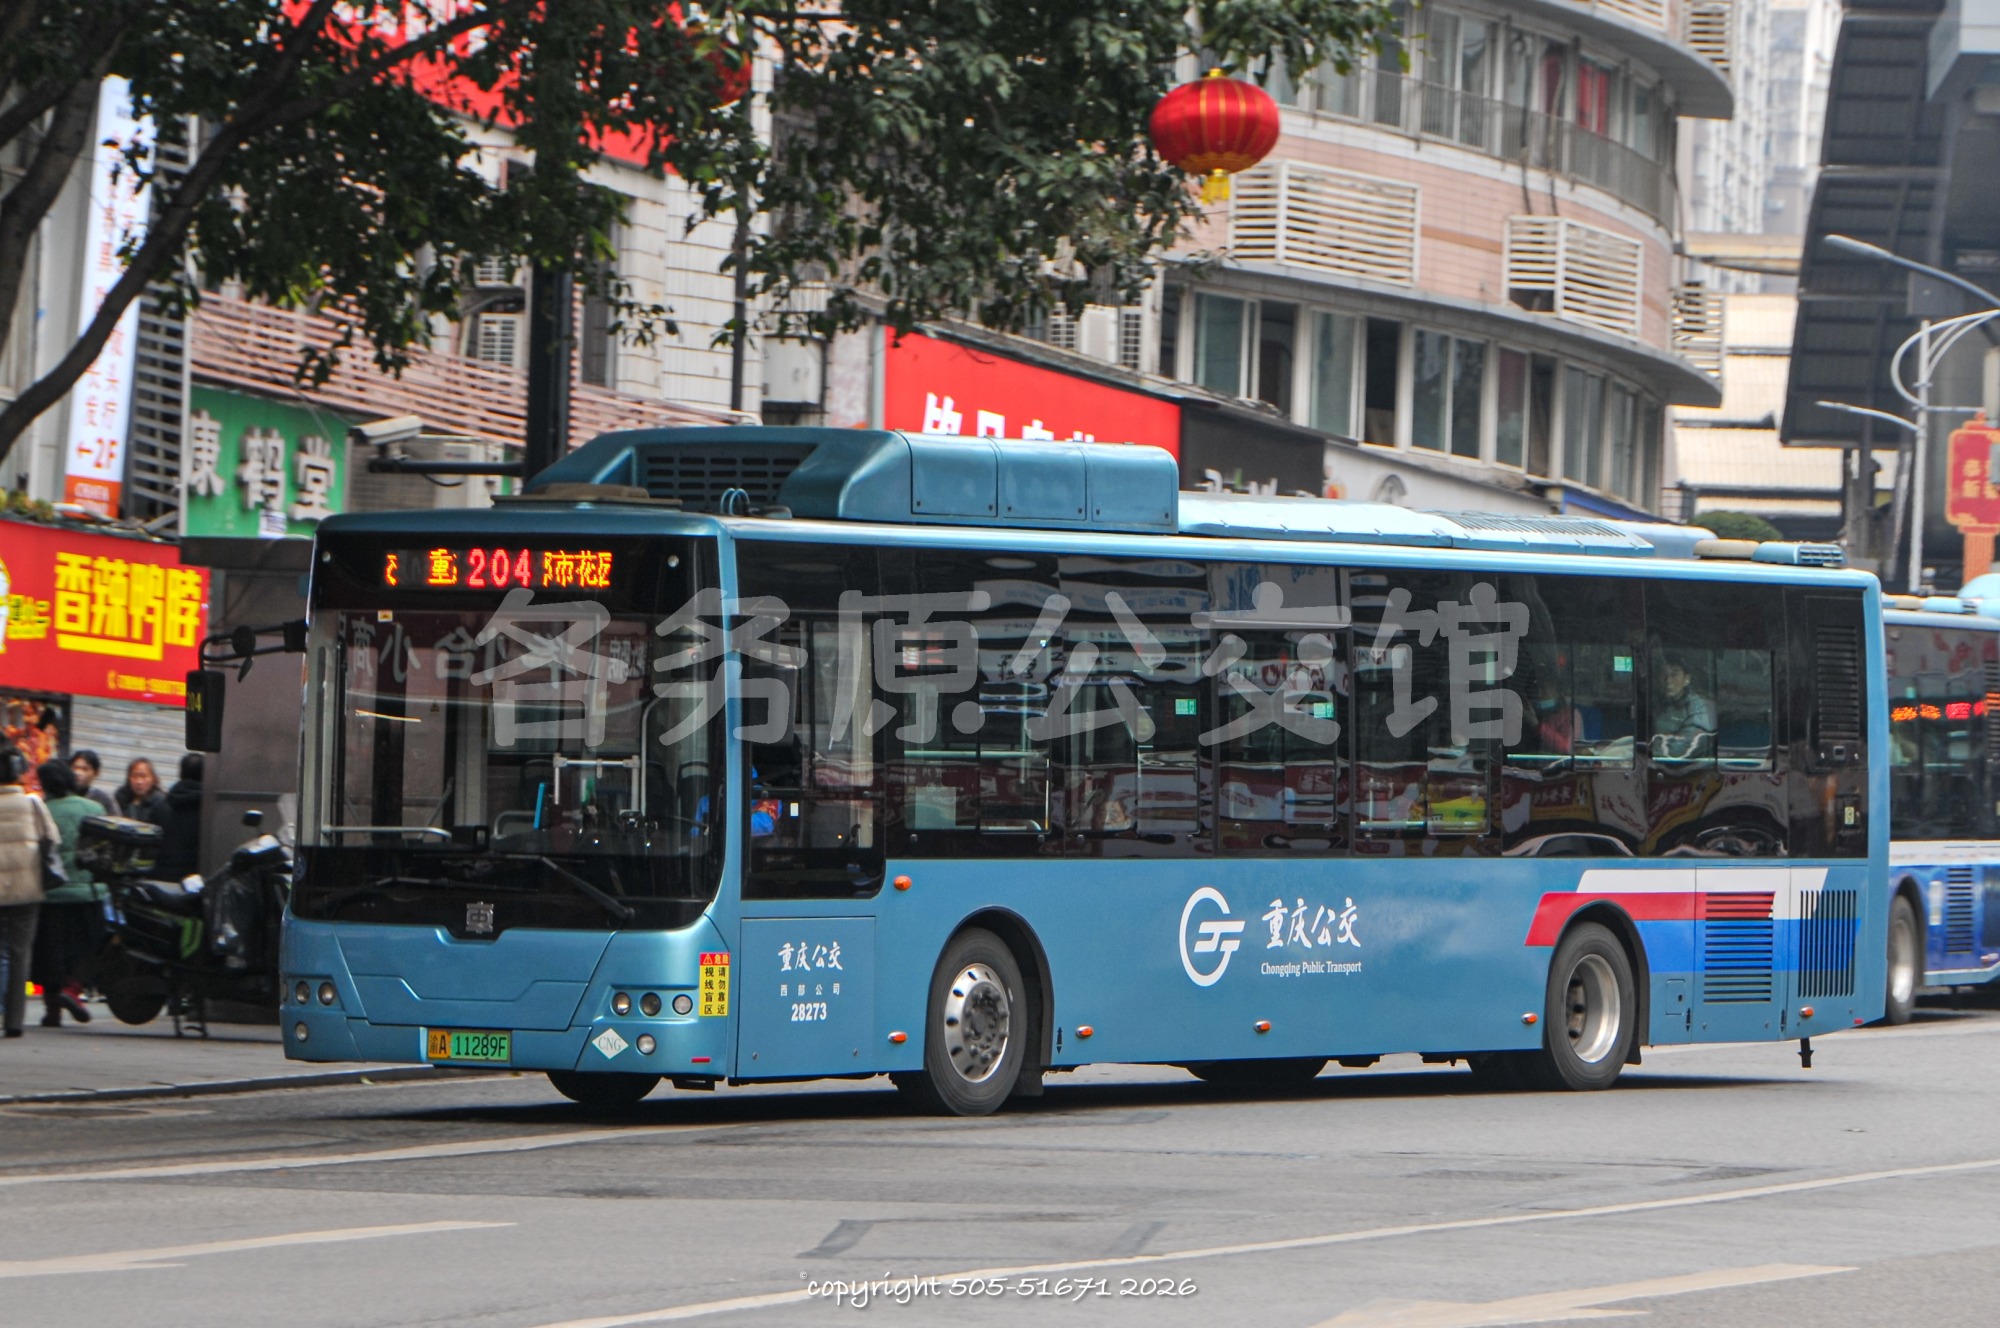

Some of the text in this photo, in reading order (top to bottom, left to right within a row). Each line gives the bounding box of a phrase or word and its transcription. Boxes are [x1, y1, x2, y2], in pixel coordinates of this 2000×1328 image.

[467, 548, 532, 588] 204
[54, 551, 203, 661] 香辣鸭脖
[1262, 897, 1362, 950] 重庆公交
[714, 953, 729, 965] 危险
[778, 941, 843, 972] 重庆公交
[1261, 960, 1362, 977] Chongqing Public Transport
[704, 967, 715, 1015] 视线盲区
[717, 967, 727, 1015] 请勿靠近
[780, 982, 841, 997] 西部公司
[791, 1001, 828, 1022] 28273
[599, 1035, 622, 1051] CNG
